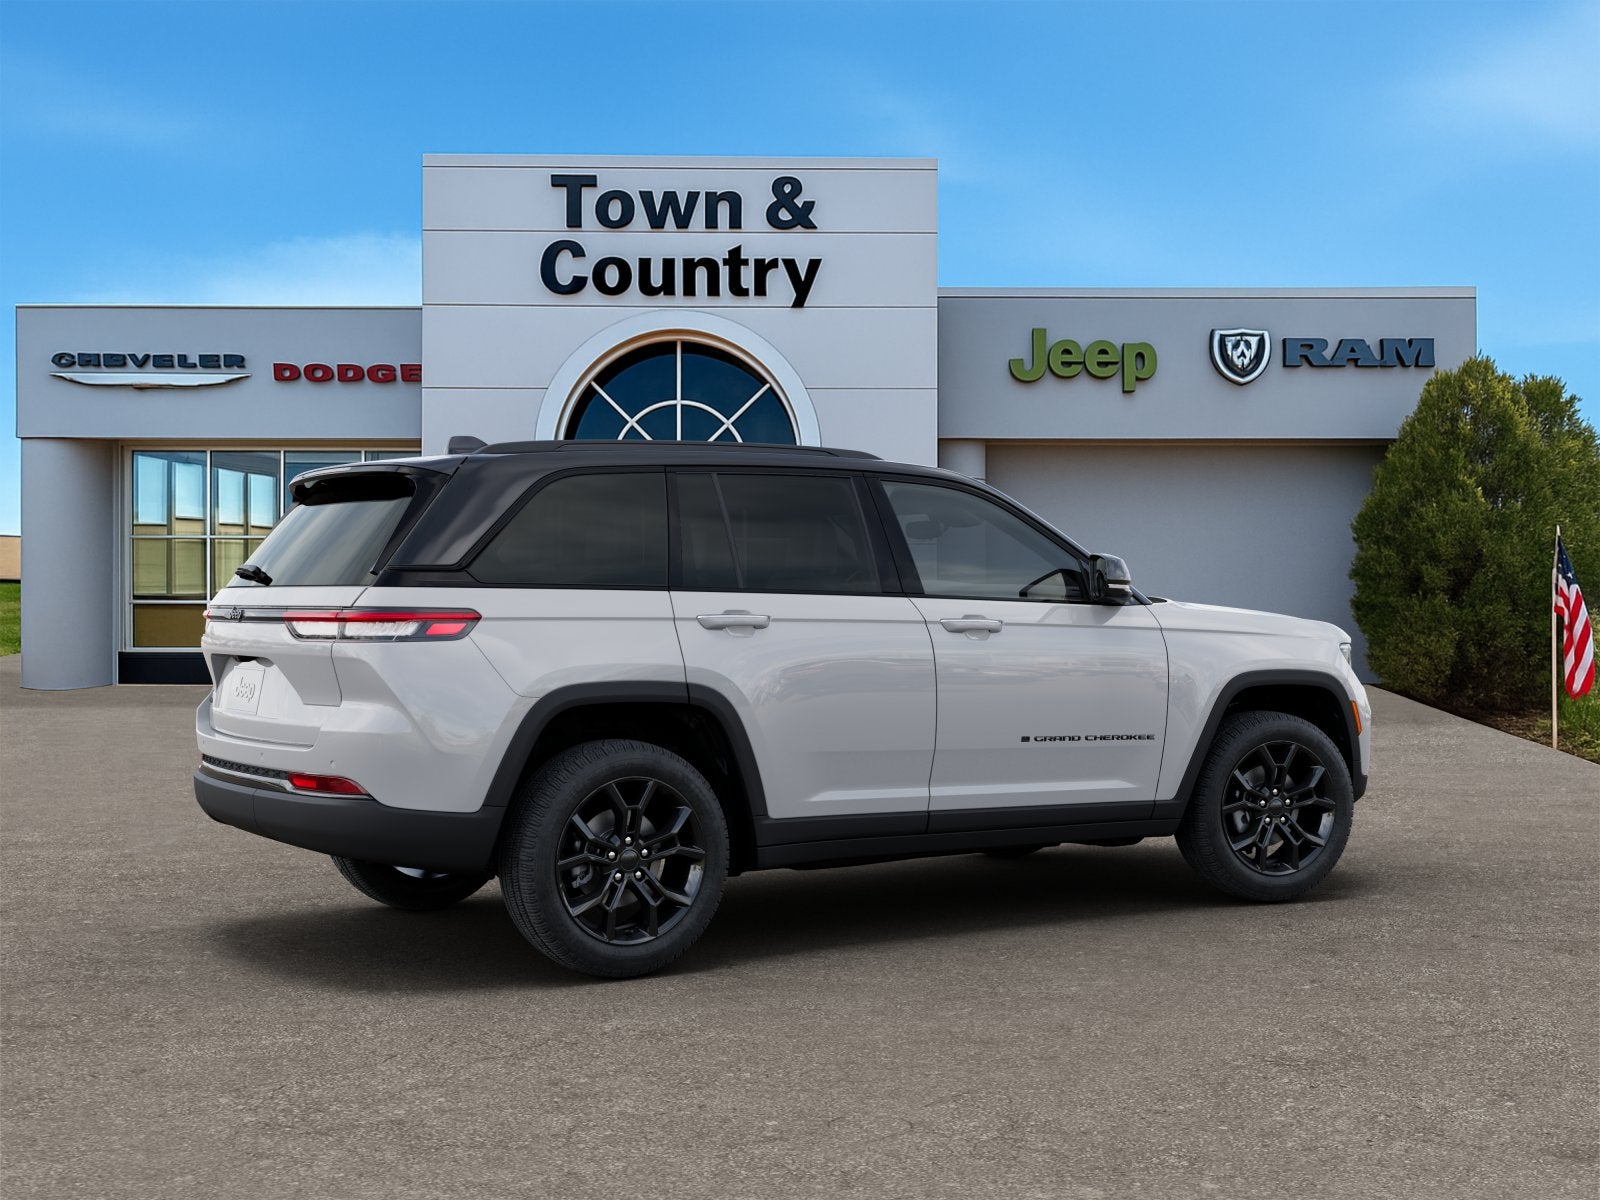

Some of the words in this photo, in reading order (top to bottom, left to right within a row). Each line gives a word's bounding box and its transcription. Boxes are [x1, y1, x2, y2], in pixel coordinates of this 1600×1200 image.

[551, 174, 742, 229] Town
[766, 176, 818, 229] &
[540, 240, 822, 308] Country
[273, 363, 422, 383] DODGE
[1009, 328, 1157, 392] Jeep
[1283, 338, 1435, 368] RAM
